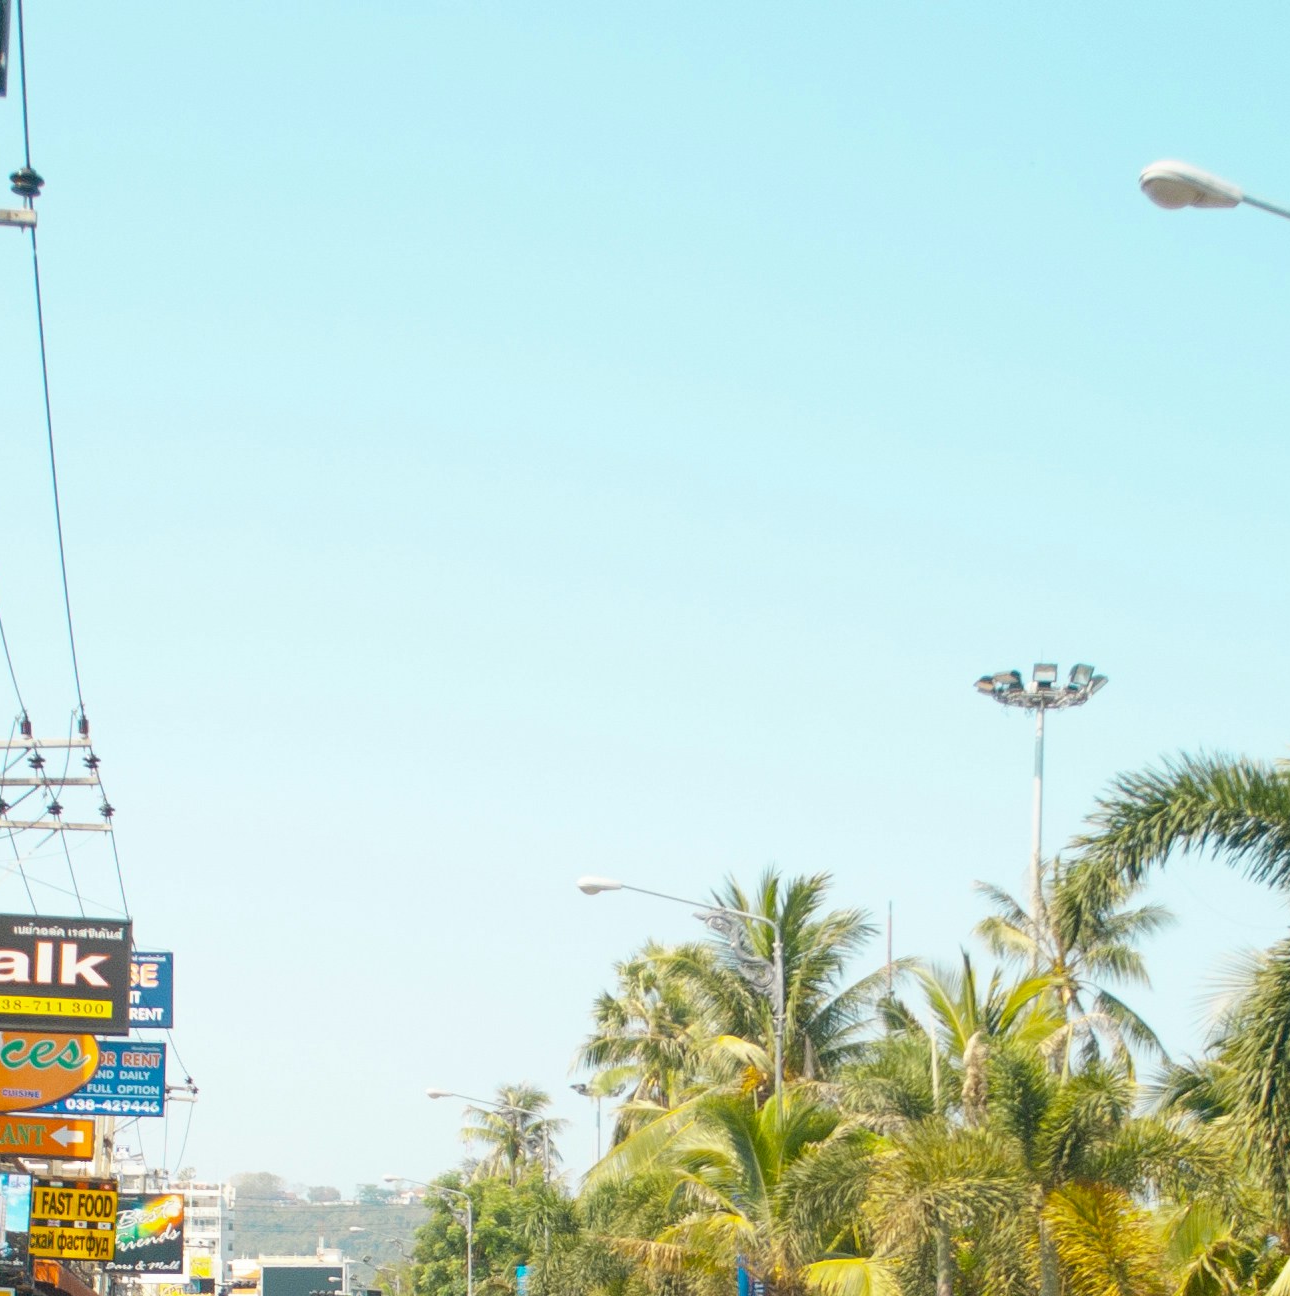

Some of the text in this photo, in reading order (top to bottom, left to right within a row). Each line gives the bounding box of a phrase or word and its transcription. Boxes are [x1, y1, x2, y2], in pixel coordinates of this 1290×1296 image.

[72, 1002, 105, 1014] 300
[129, 1008, 164, 1021] RENT
[99, 1053, 161, 1069] OR RENT
[119, 1070, 150, 1081] DAILY
[2, 1089, 41, 1099] CUISINE
[87, 1083, 160, 1095] FULL OPTION
[65, 1099, 160, 1113] 038-429446
[42, 1191, 74, 1216] FAST
[77, 1194, 113, 1218] FOOD
[29, 1231, 54, 1250] скай
